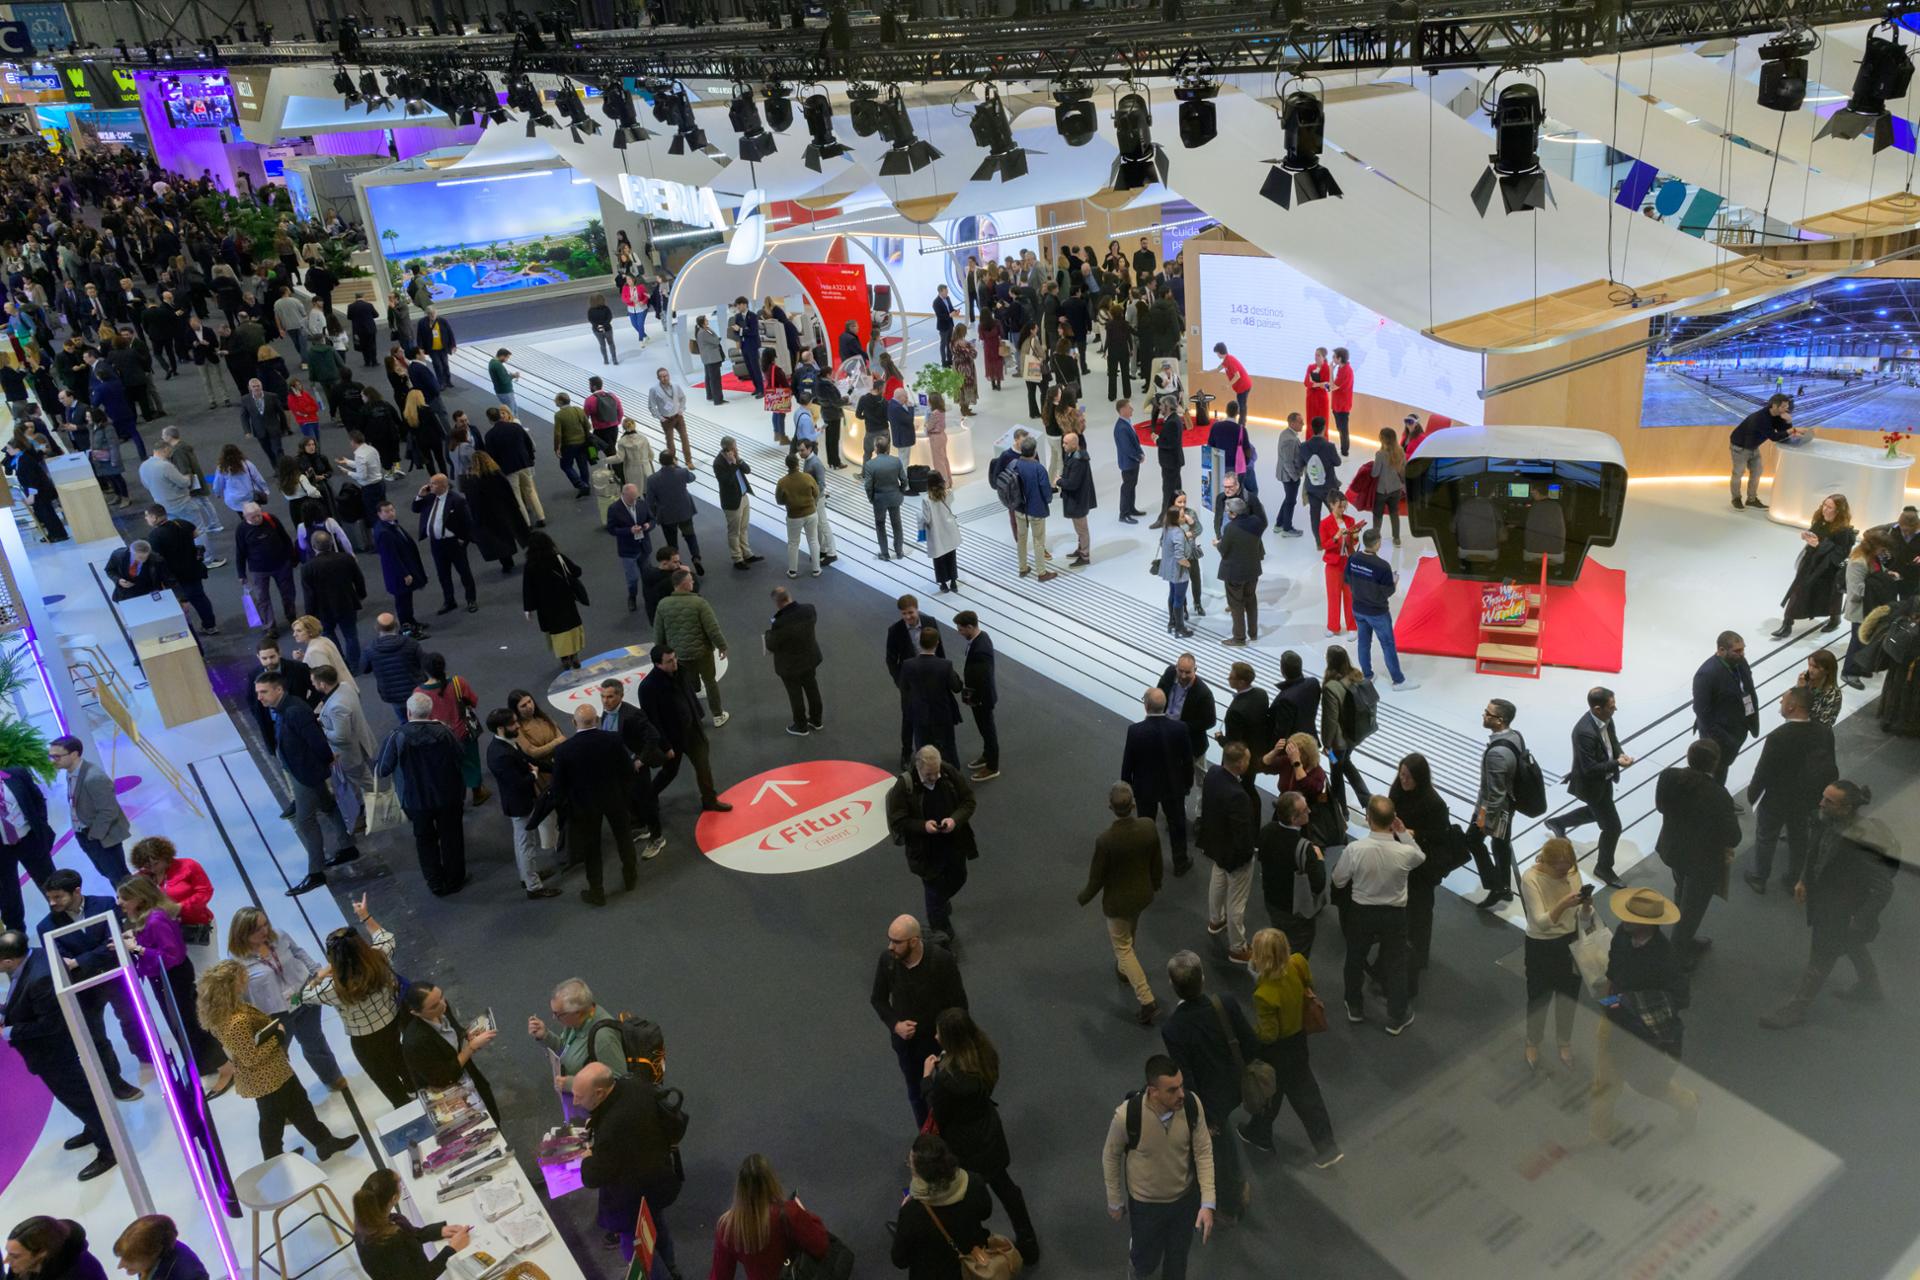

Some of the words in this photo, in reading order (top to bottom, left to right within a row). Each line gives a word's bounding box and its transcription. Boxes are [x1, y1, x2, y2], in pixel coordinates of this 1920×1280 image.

[0, 26, 24, 53] C
[618, 173, 729, 232] IBERIA
[1171, 226, 1200, 237] Cuida
[1171, 241, 1184, 252] pa
[1230, 317, 1242, 325] en
[1243, 316, 1255, 326] 48
[1231, 304, 1249, 314] 143
[1250, 306, 1284, 318] destinos
[583, 676, 632, 696] Fir
[778, 807, 852, 845] Fitur
[815, 828, 851, 848] Talent
